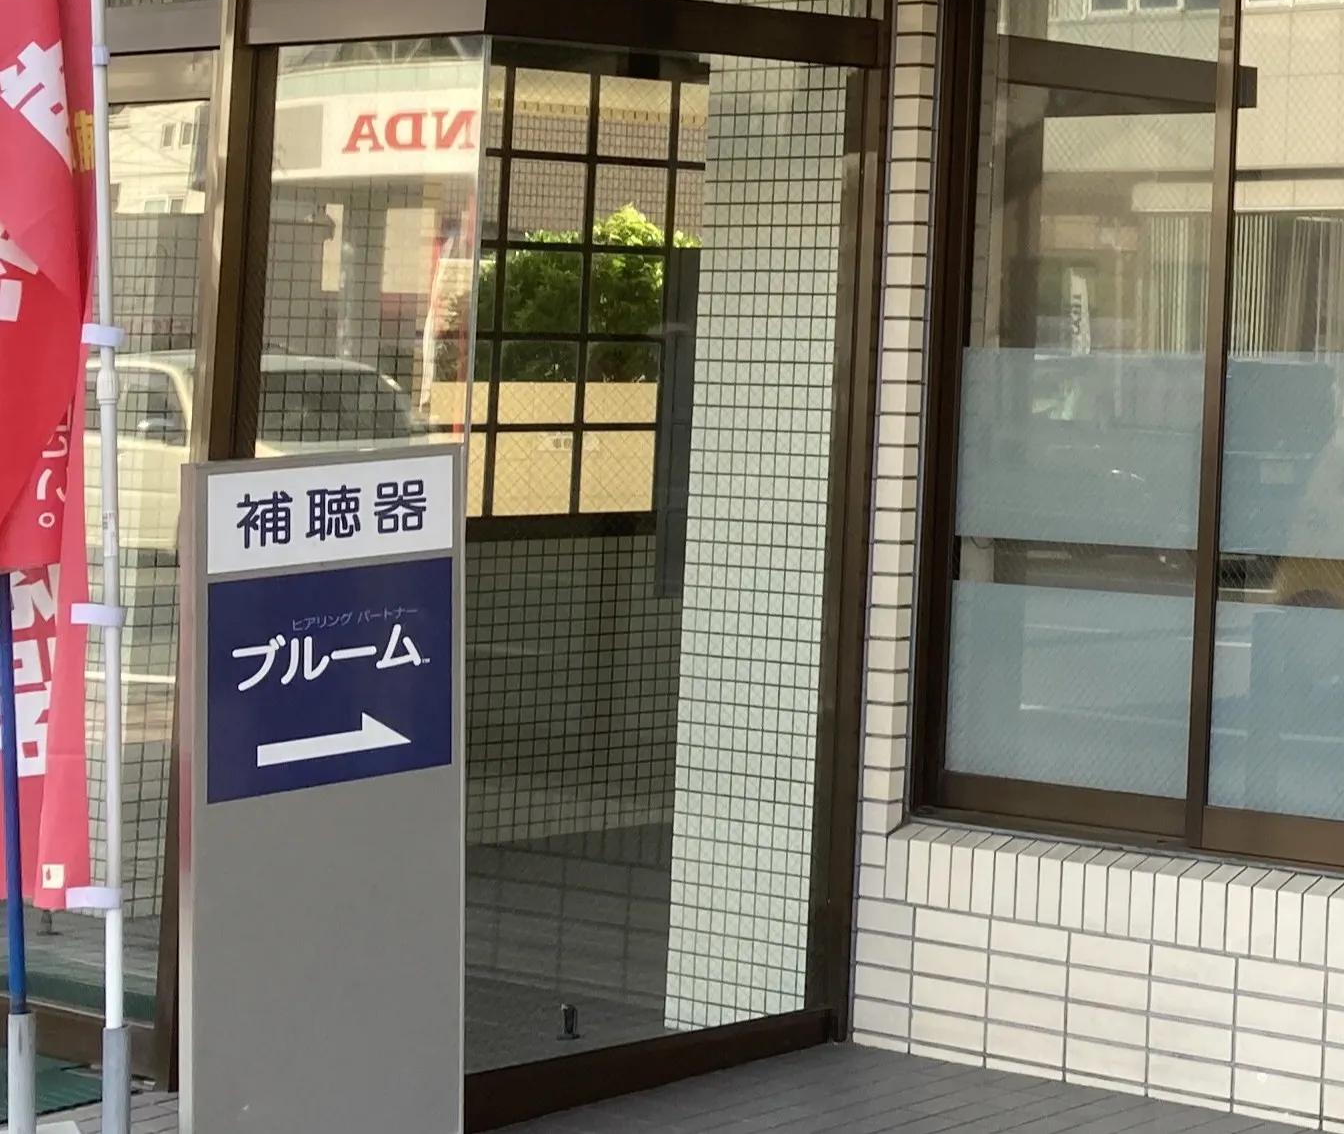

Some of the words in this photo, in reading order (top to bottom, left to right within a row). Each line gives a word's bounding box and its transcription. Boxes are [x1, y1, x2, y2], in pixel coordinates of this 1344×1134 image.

[236, 479, 427, 549] 補聴器
[358, 606, 418, 623] パートナー
[232, 623, 422, 692] ブルーム
